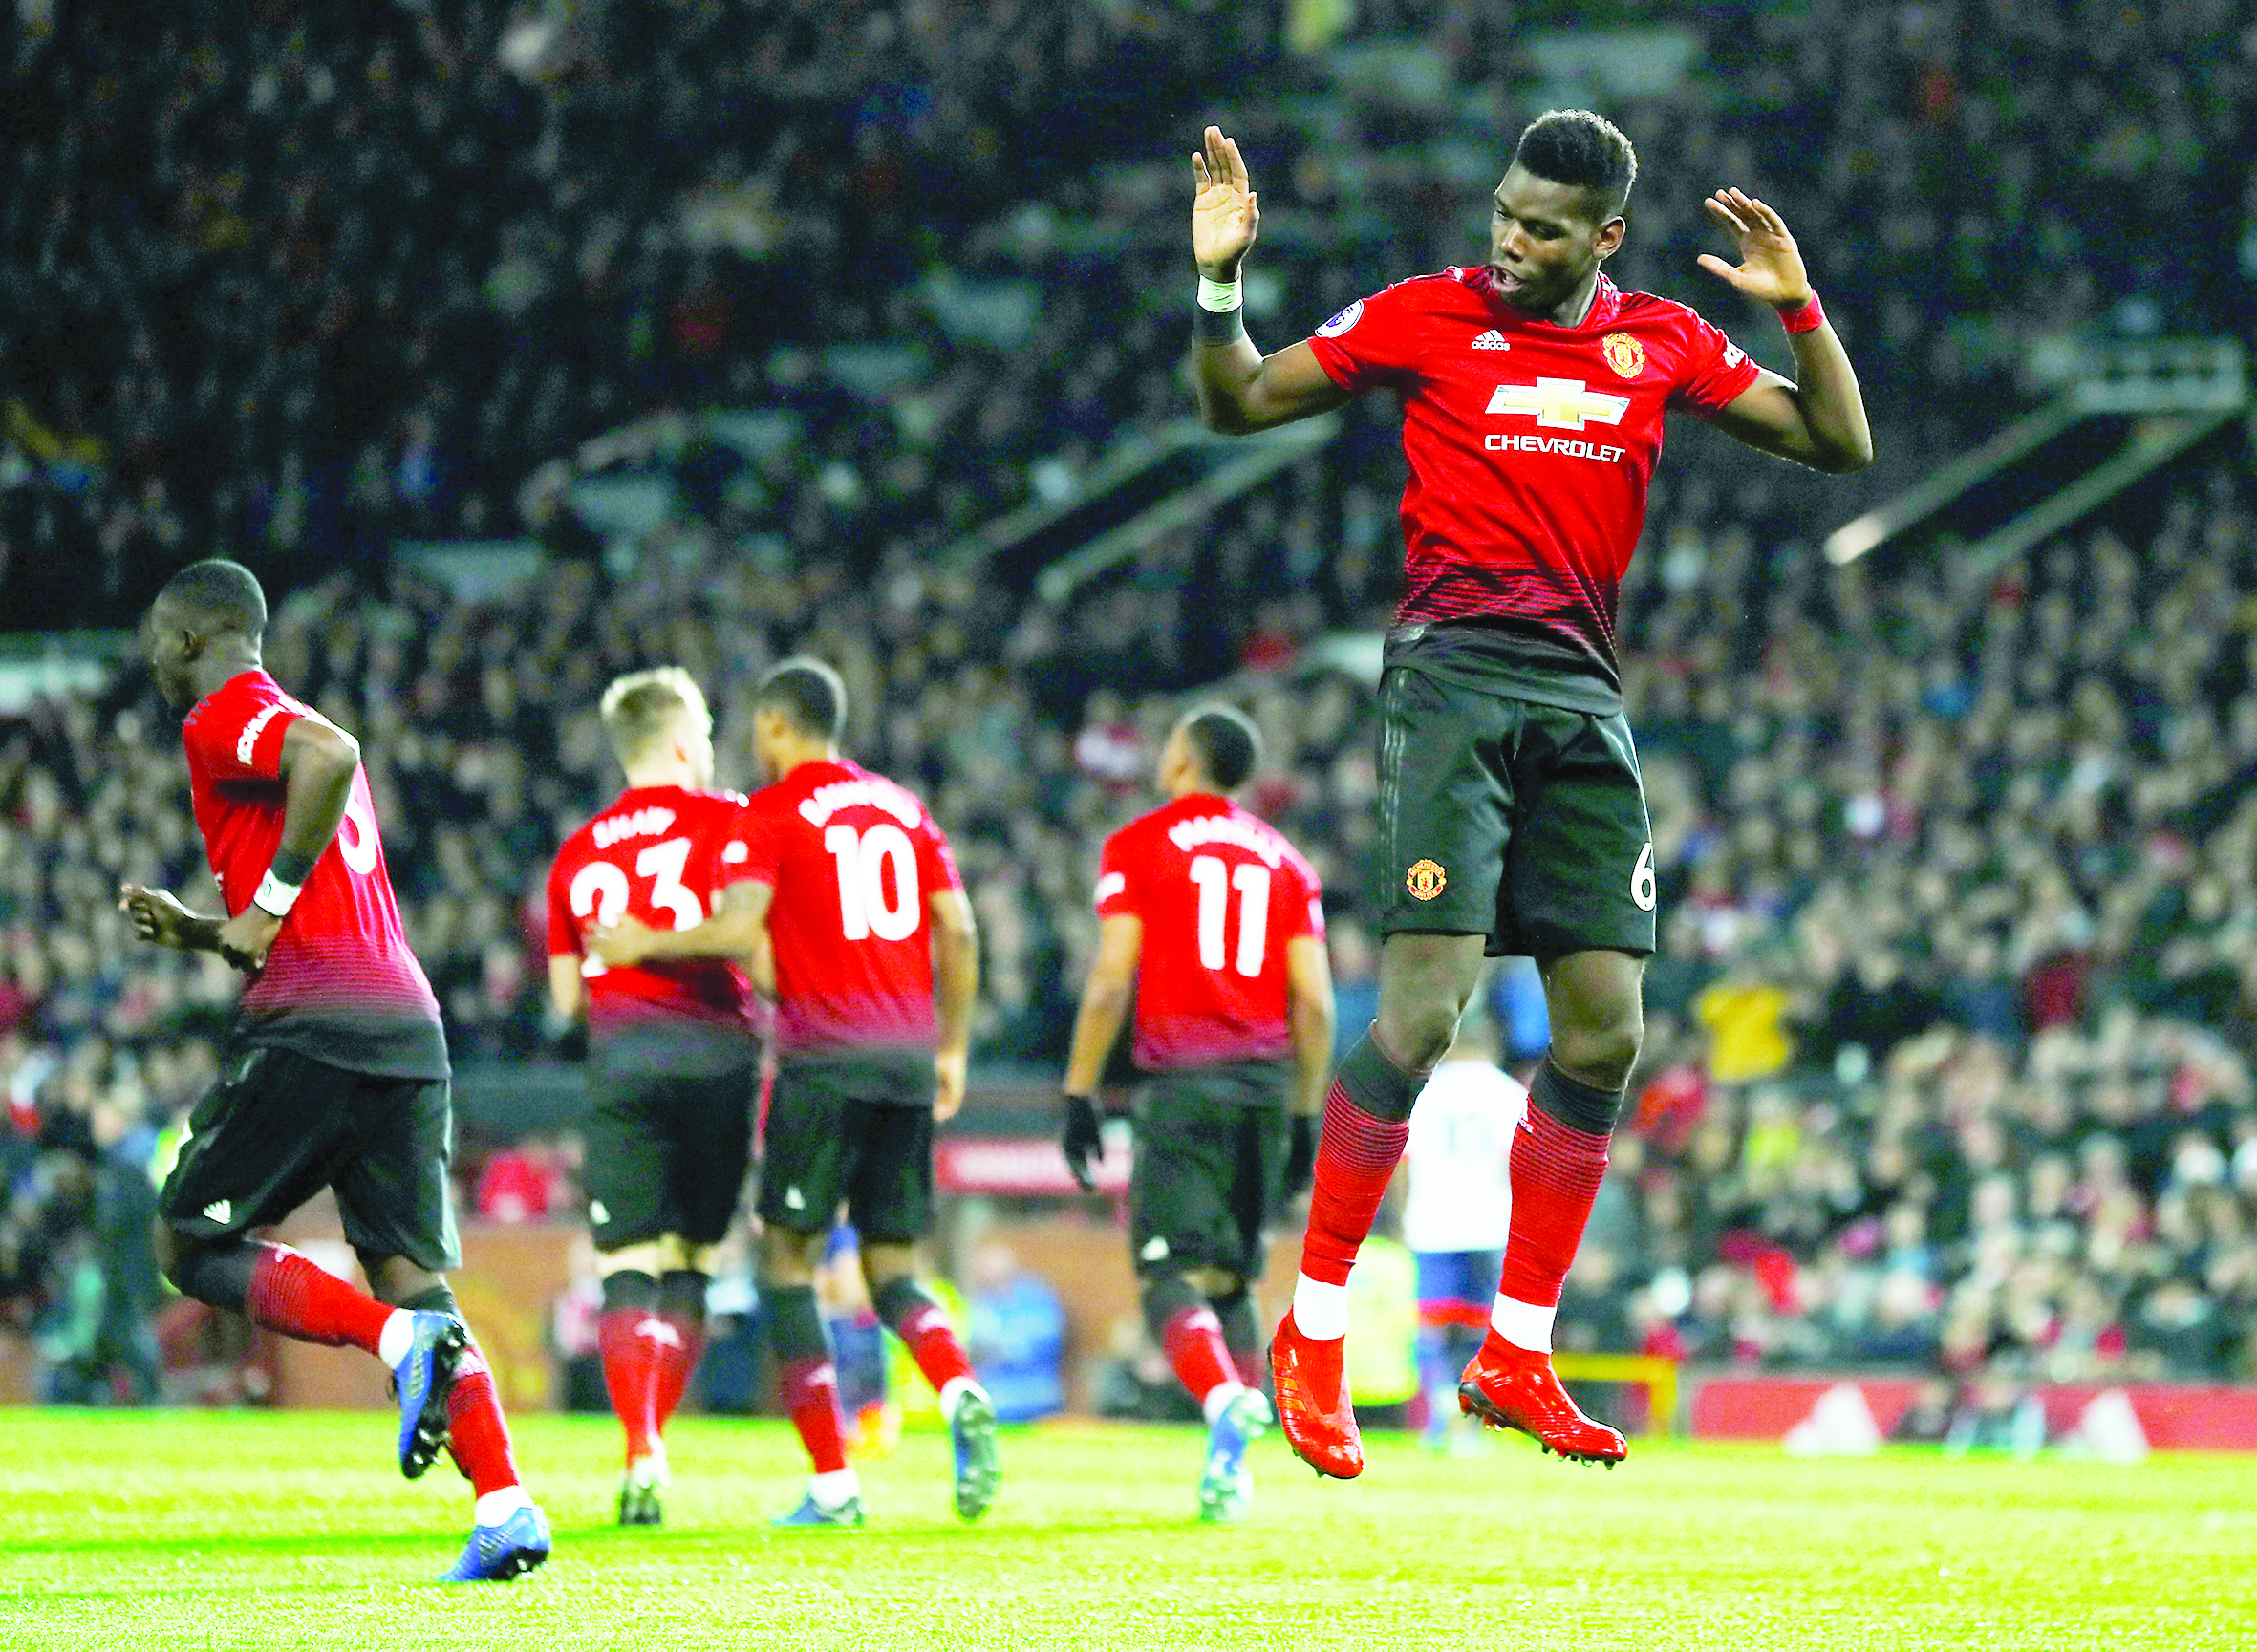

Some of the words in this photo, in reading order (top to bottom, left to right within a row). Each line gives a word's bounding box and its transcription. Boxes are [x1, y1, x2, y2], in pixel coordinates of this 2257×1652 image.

[1471, 339, 1511, 352] adidas
[1484, 434, 1626, 464] CHEVROLET
[825, 824, 920, 941] 10
[1408, 861, 1444, 877] MANCHESTER
[1630, 841, 1657, 912] 6
[1189, 855, 1271, 978] 11
